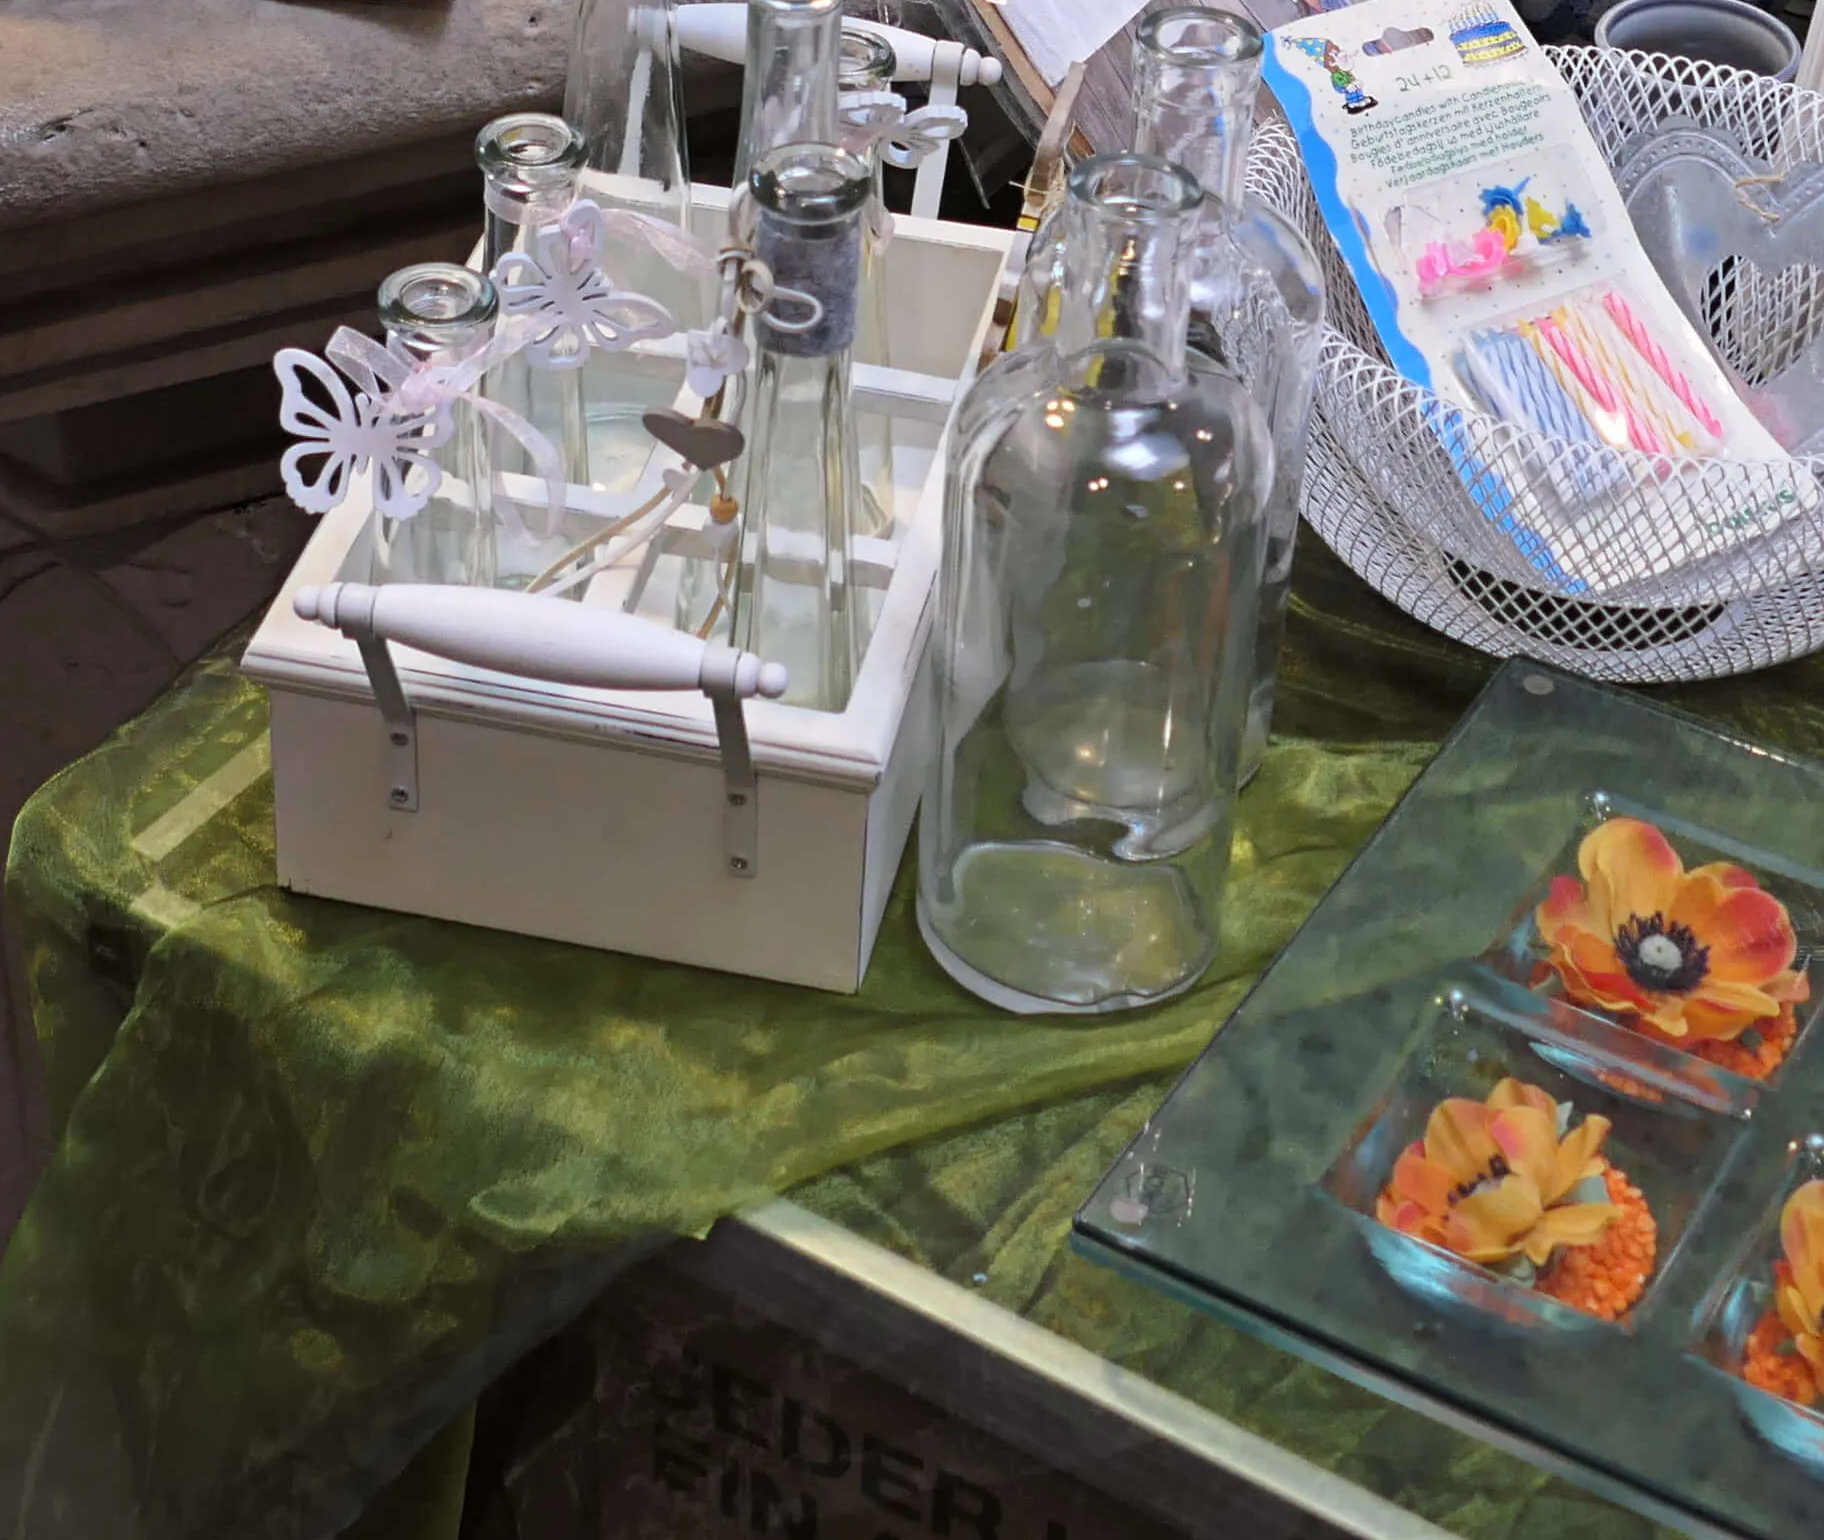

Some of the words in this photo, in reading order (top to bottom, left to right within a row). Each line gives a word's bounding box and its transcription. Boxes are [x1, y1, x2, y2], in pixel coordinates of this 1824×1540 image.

[1439, 96, 1460, 110] with
[1350, 144, 1392, 165] Bougies
[1472, 112, 1499, 127] avec
[1502, 93, 1552, 117] Bougeoirs
[1351, 113, 1452, 150] Geburtstagskerzen
[1454, 104, 1469, 119] mit
[1460, 127, 1483, 142] med
[1471, 135, 1492, 149] med
[1479, 147, 1501, 161] met
[1502, 132, 1544, 153] Houders
